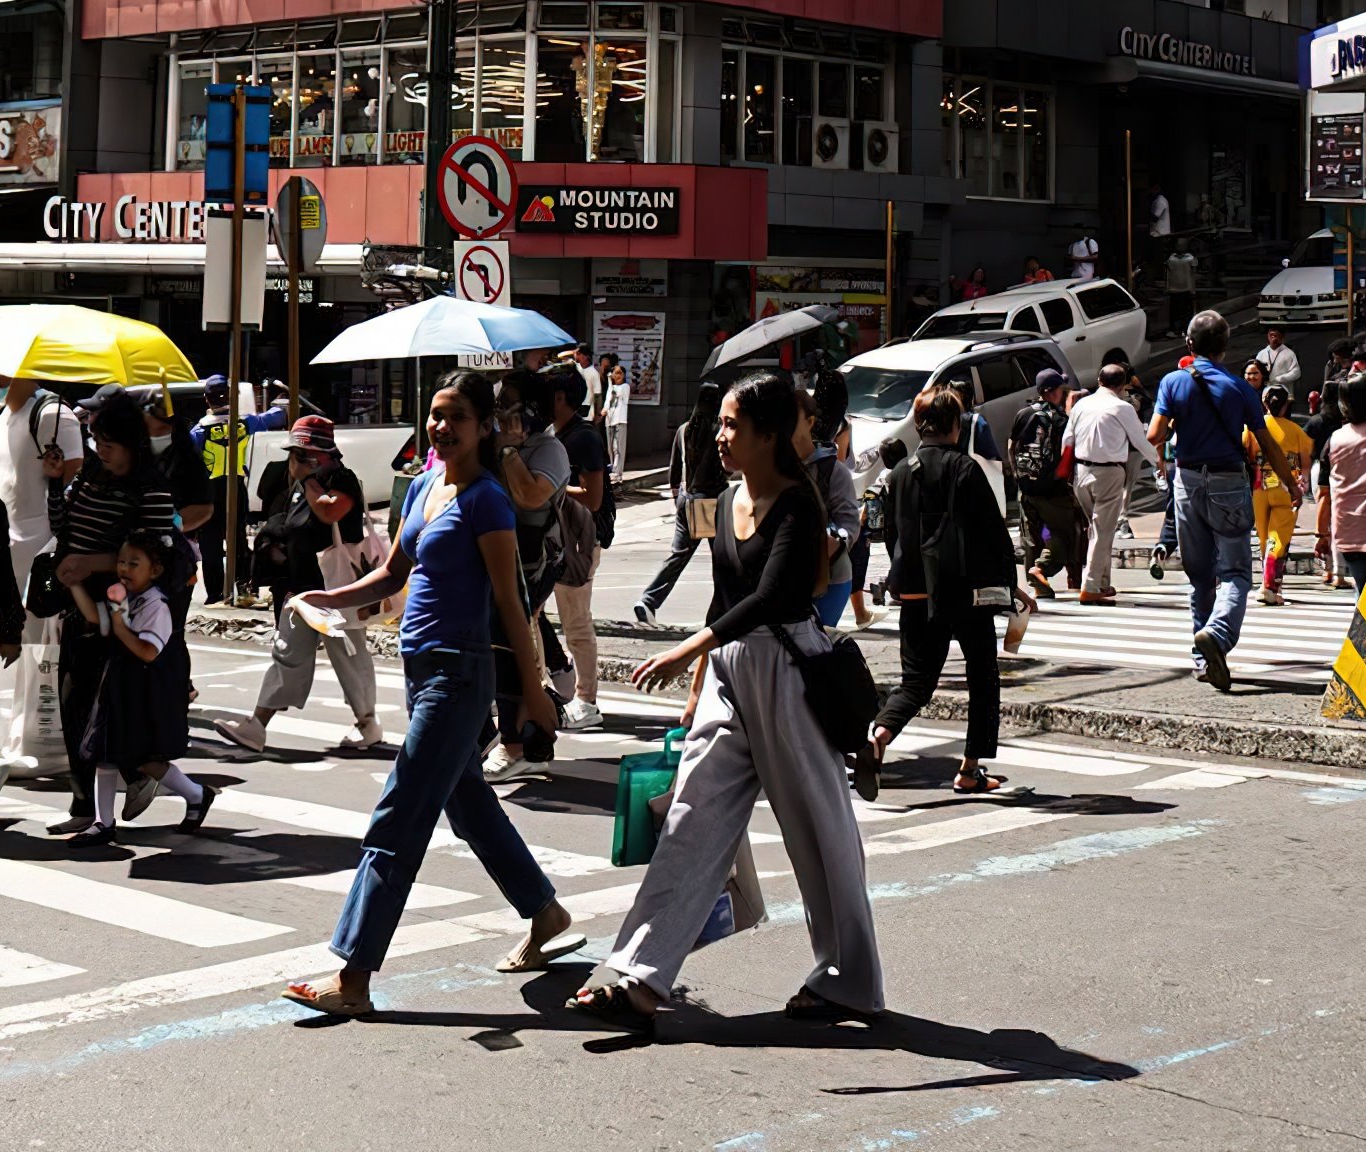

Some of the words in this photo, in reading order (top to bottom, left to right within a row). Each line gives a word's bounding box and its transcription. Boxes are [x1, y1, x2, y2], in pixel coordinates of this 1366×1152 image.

[1120, 26, 1156, 58] CITY
[1159, 33, 1212, 67] CENTER
[1214, 50, 1256, 75] HOTEL
[559, 190, 675, 208] MOUNTAIN
[43, 195, 104, 238] CITY
[574, 212, 659, 230] STUDIO
